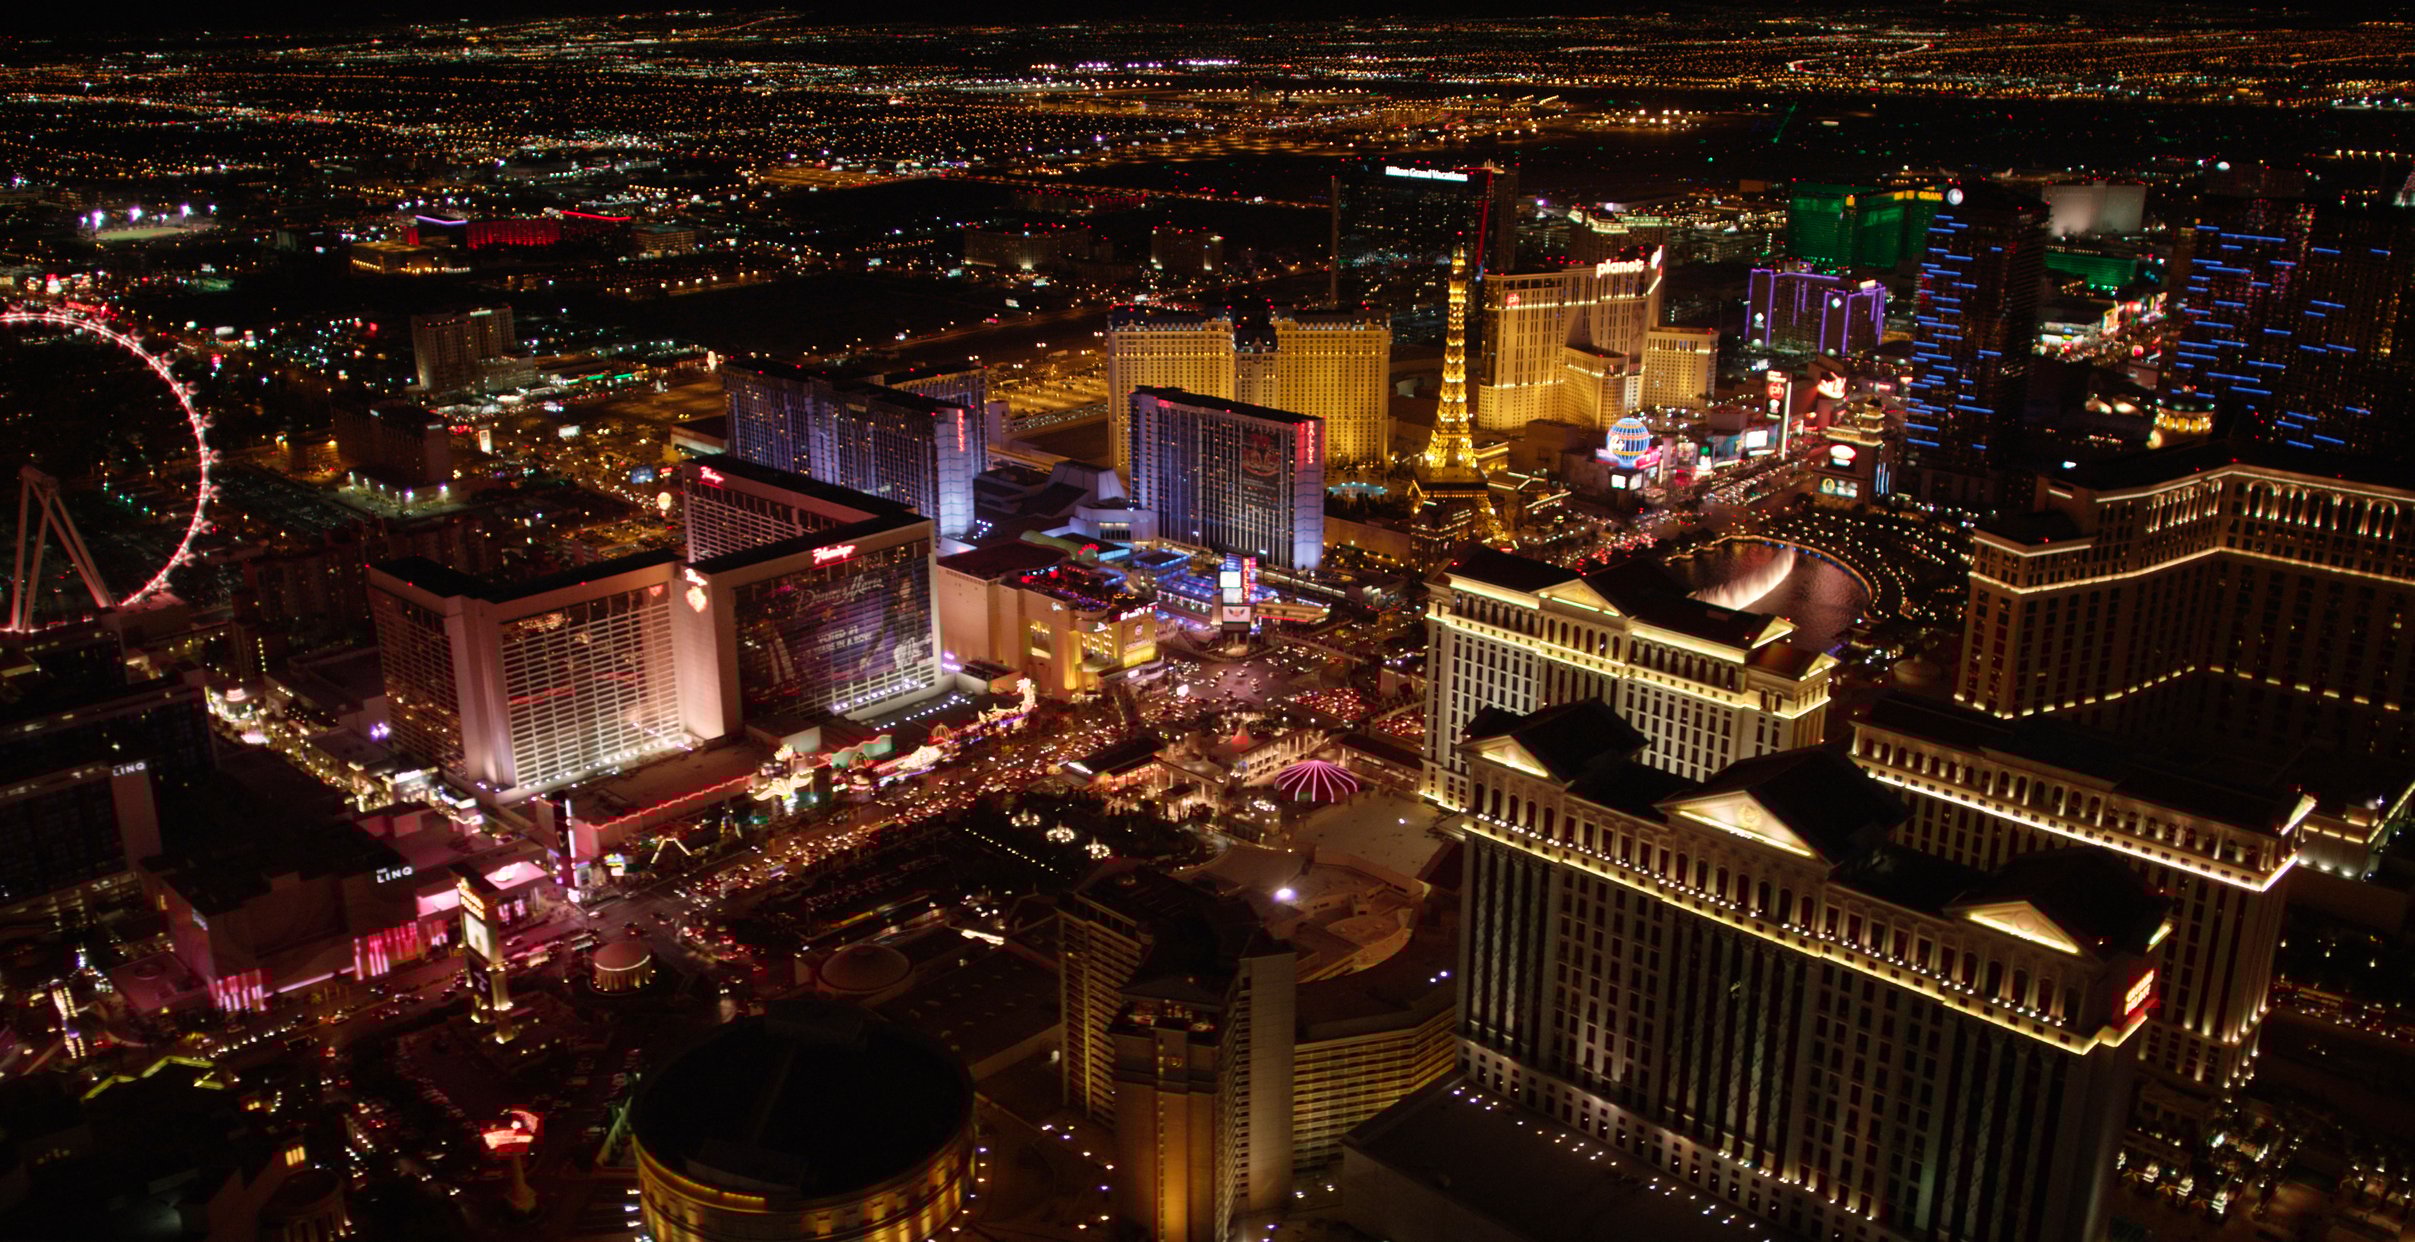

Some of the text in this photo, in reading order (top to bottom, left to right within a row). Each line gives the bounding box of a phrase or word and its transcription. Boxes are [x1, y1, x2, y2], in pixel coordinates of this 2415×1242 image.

[1386, 166, 1468, 182] Hilton Grand Vacations
[1596, 258, 1644, 279] planet
[112, 761, 146, 776] LINQ
[376, 866, 413, 884] LINQ
